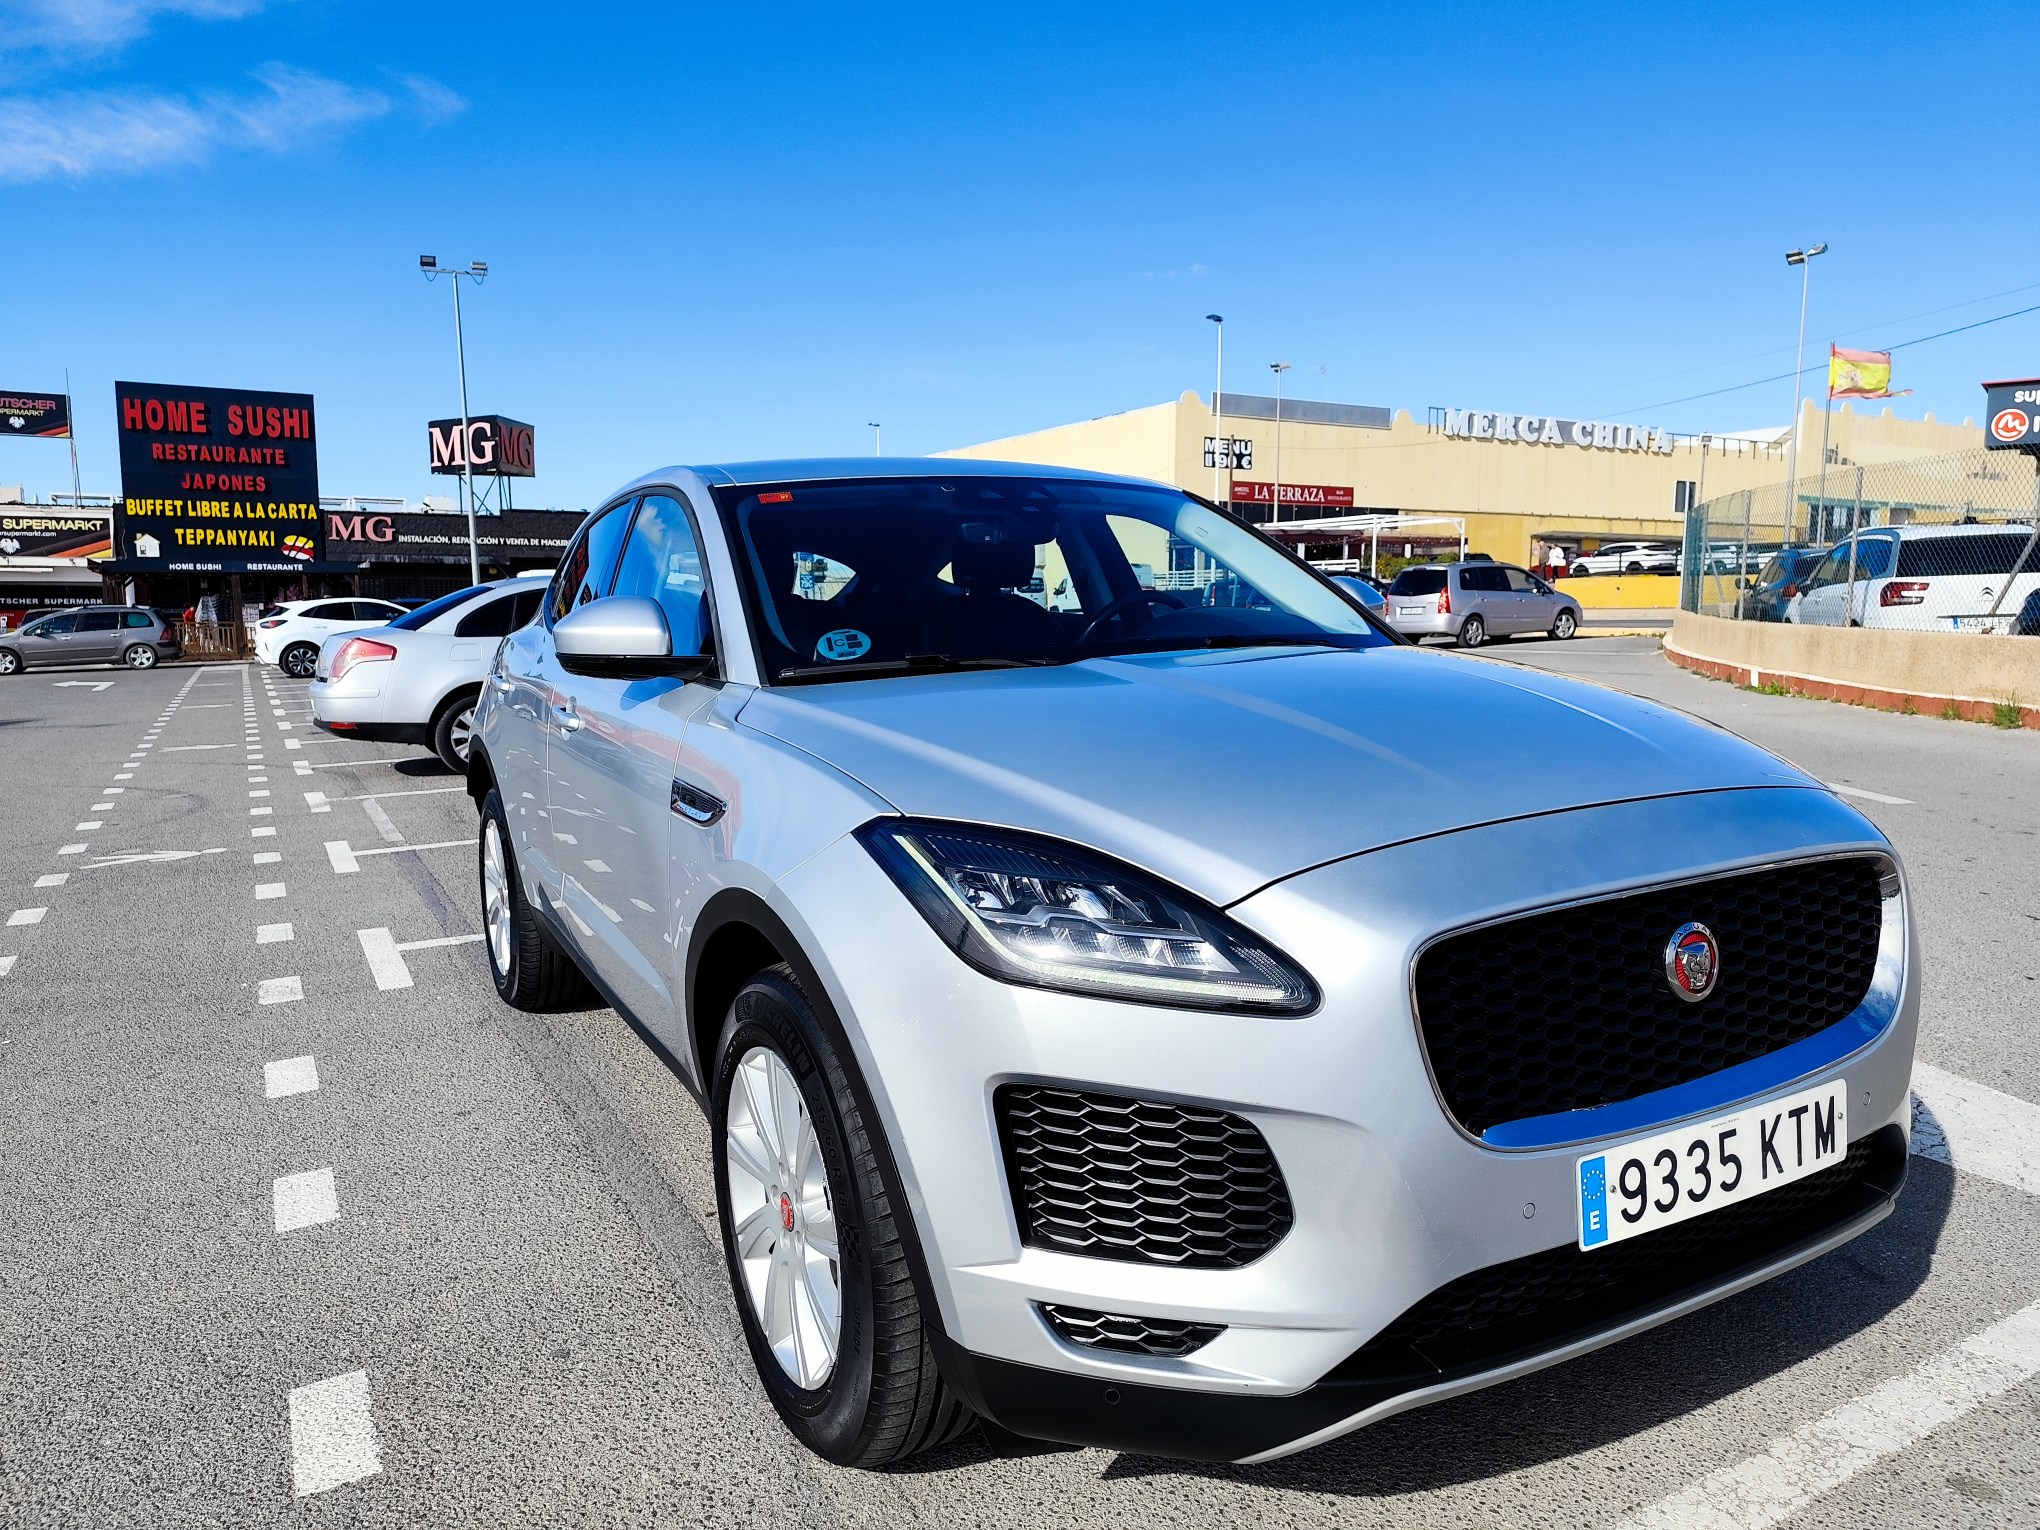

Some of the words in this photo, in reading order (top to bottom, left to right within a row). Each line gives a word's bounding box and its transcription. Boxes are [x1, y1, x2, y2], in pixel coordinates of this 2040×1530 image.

[123, 398, 207, 433] HOME
[227, 404, 310, 439] SUSHI
[1444, 408, 1564, 445] MERCA
[1572, 420, 1673, 455] CHINA
[152, 443, 286, 466] RESTAURANTE
[429, 421, 496, 467] MG
[498, 423, 534, 469] MG
[1204, 437, 1252, 455] MENÚ
[1241, 455, 1252, 470] €
[181, 473, 266, 492] JAPONES
[1254, 485, 1270, 500] LA
[1271, 486, 1325, 502] TERRAZA
[126, 498, 183, 517] BUFFET
[187, 500, 230, 518] LIBRE
[233, 502, 244, 518] A
[246, 502, 265, 519] LA
[267, 503, 318, 520] CARTA
[2, 518, 103, 531] SUPERMARKT
[328, 515, 396, 542] MG
[174, 528, 276, 547] TEPPANYAKI
[452, 535, 498, 545] REPAACIÓN
[500, 537, 505, 545] Y
[506, 537, 530, 545] VENTA
[530, 538, 540, 546] DE
[169, 563, 194, 571] HOME
[196, 563, 222, 571] SUSHI
[247, 563, 304, 571] RESTAURANTE
[1670, 922, 1714, 951] JAGUAR
[811, 1092, 838, 1159] 235/60
[1589, 1209, 1600, 1231] E
[1618, 1128, 1743, 1224] 9335
[1759, 1095, 1836, 1180] KTM
